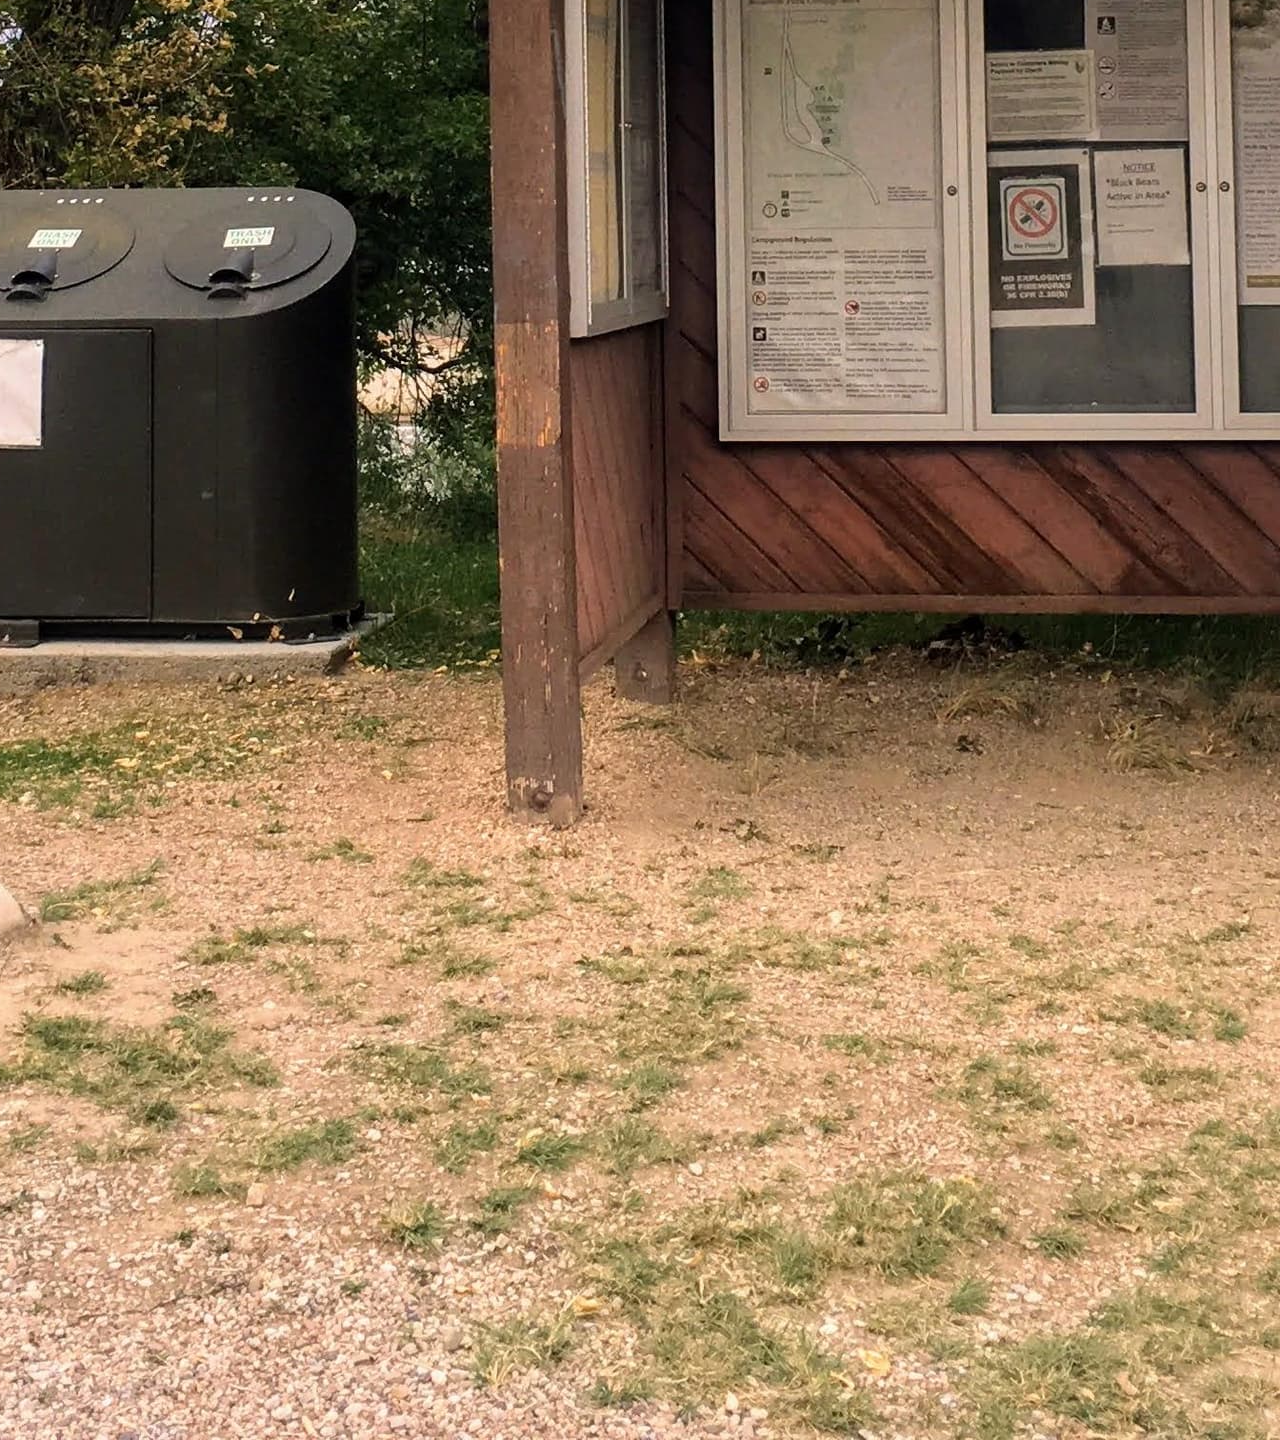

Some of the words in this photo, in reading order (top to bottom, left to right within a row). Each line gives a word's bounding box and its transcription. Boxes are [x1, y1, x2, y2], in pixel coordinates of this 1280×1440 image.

[1122, 162, 1156, 172] NOTICE
[229, 229, 272, 237] TRASH
[231, 236, 264, 244] ONLY
[1016, 273, 1072, 282] EXPLOSIVES
[1017, 282, 1071, 290] FIREWORKS
